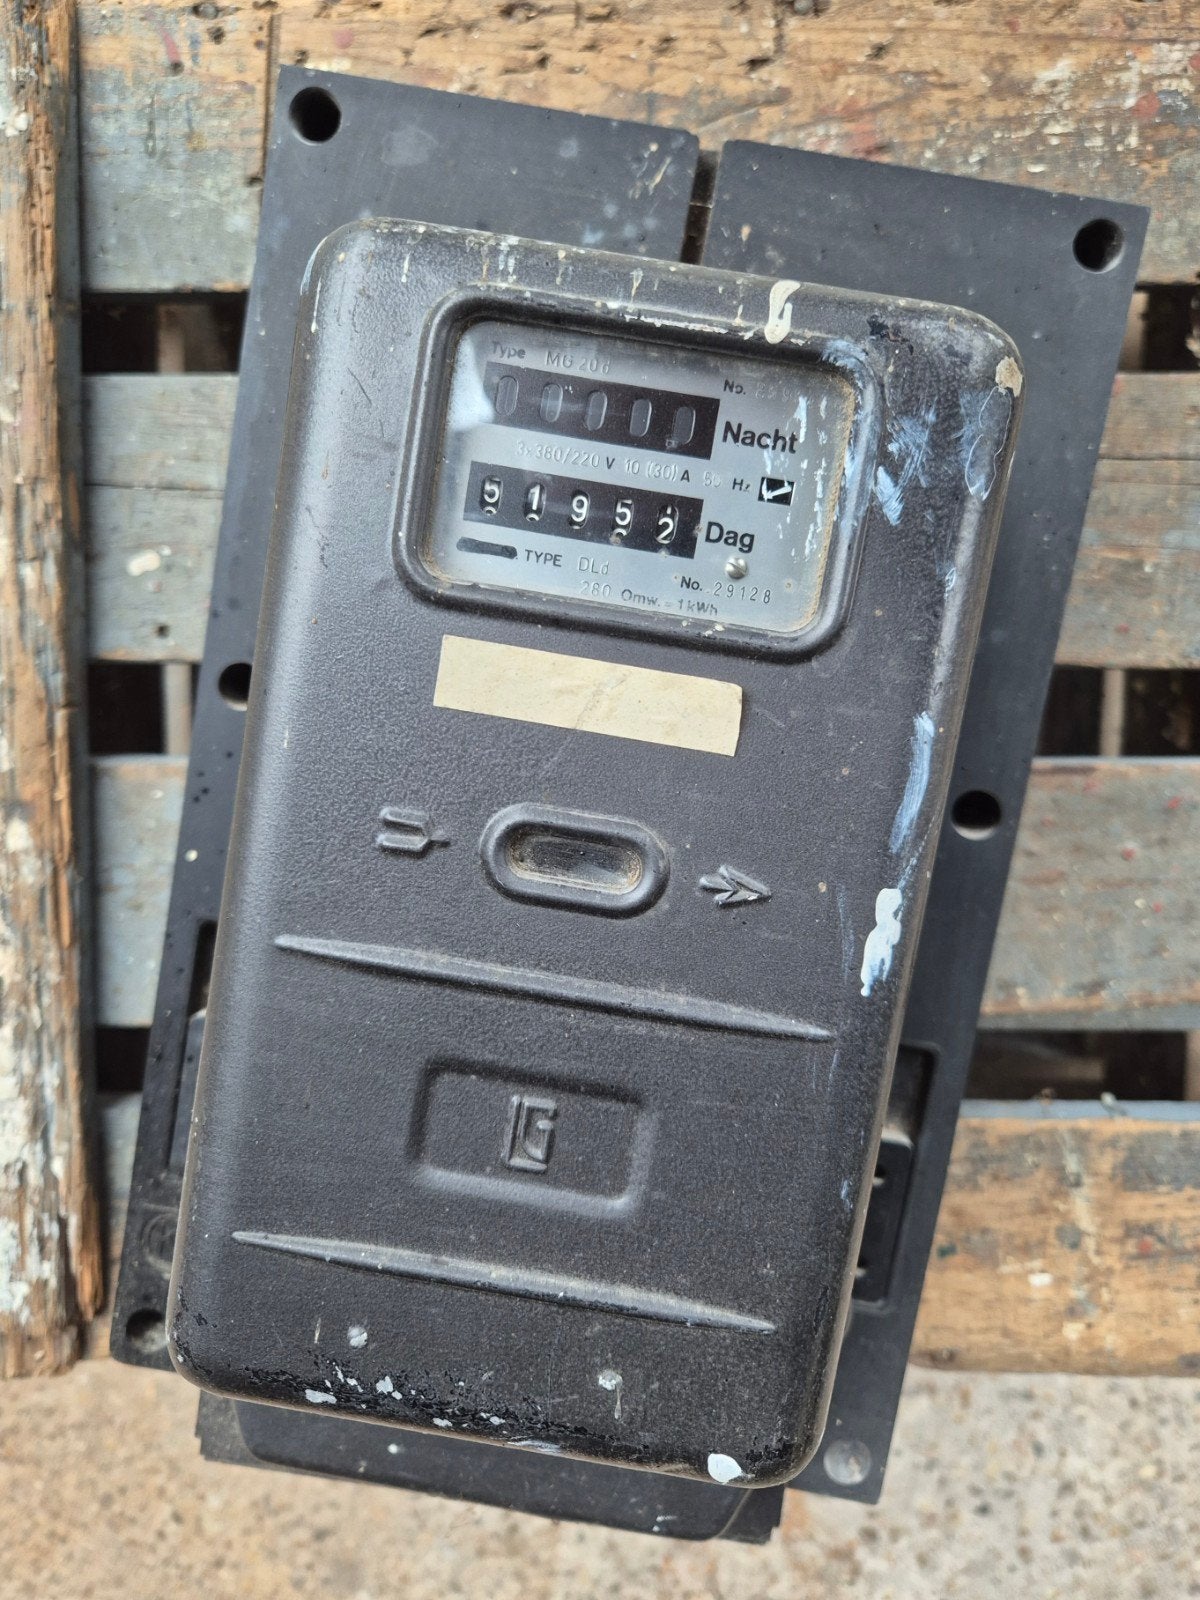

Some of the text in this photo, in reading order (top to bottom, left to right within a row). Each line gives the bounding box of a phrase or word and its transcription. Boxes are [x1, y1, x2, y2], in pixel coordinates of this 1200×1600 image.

[491, 340, 526, 360] Type
[545, 350, 573, 369] MG
[722, 420, 798, 454] Nacht
[606, 456, 616, 470] V
[680, 469, 690, 482] A
[705, 521, 756, 554] Dag
[525, 549, 562, 568] TYPE
[580, 580, 611, 598] 280
[680, 576, 771, 604] No. 29128
